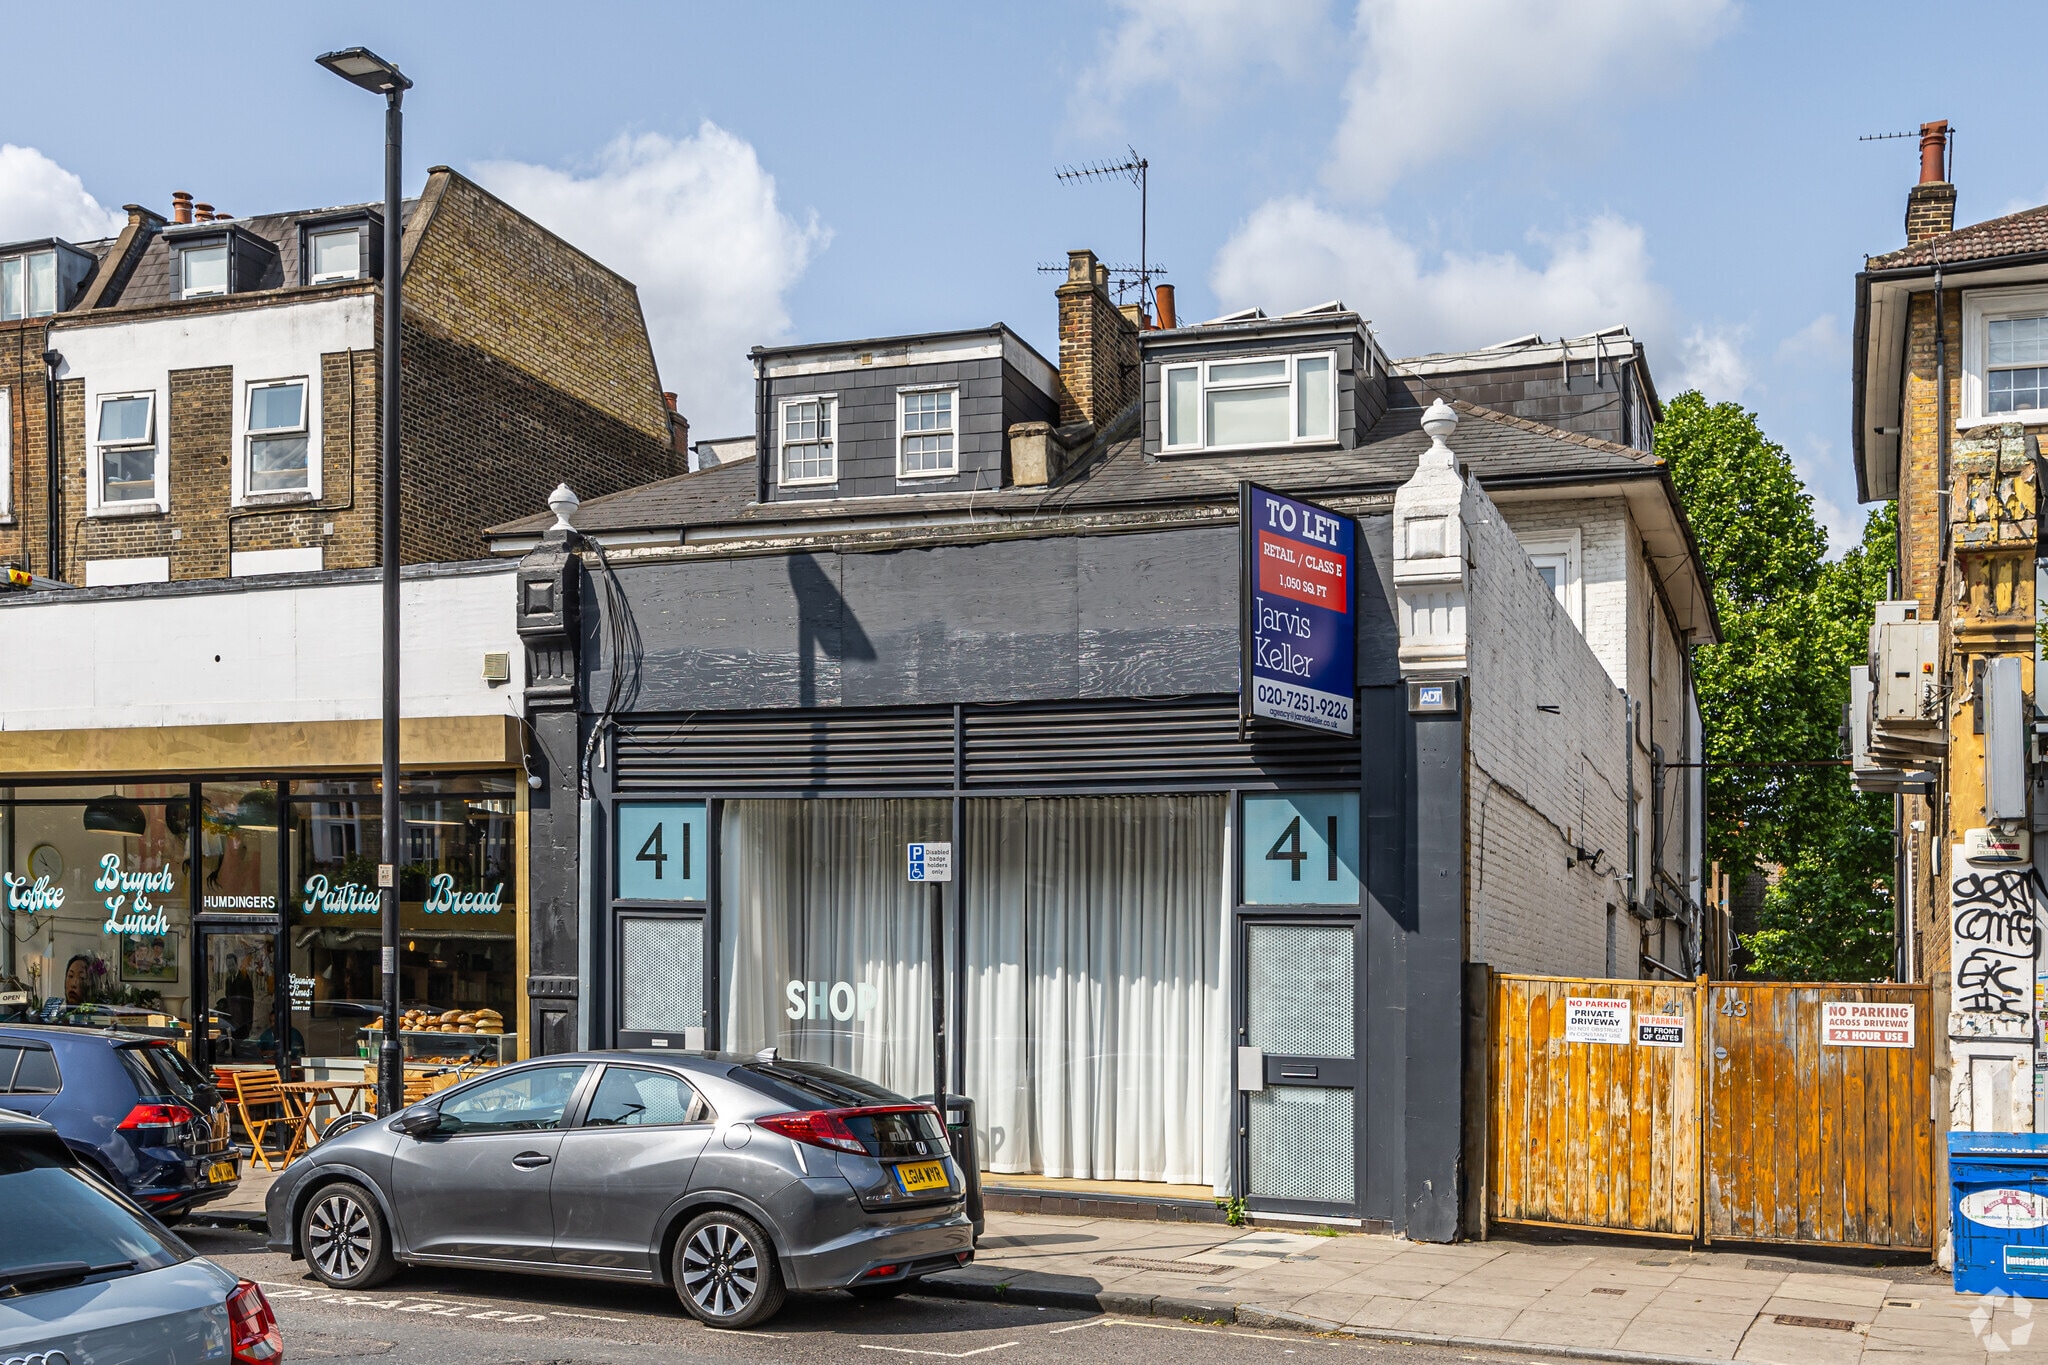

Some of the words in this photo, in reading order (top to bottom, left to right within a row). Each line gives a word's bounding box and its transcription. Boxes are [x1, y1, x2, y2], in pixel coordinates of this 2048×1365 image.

[1266, 498, 1297, 532] TO
[1302, 510, 1340, 546] LET
[1263, 542, 1296, 563] RETAIL
[1305, 555, 1334, 575] CLASS
[1336, 564, 1342, 577] E
[1279, 574, 1301, 590] 1,050
[1316, 584, 1327, 597] FT
[1254, 596, 1311, 639] Jarvis
[1255, 636, 1313, 678] Keller
[1258, 684, 1348, 720] 020-7251-9226
[1421, 690, 1442, 702] ADT
[1269, 707, 1338, 729] agency@jarviskeller.co.uk
[635, 822, 691, 880] 41
[913, 846, 922, 860] P
[1265, 815, 1338, 882] 41
[94, 853, 175, 893] Brunch
[3, 871, 66, 913] Coffee
[132, 890, 153, 913] &
[203, 895, 276, 909] HUMDINGERS
[302, 873, 383, 915] Pastries
[423, 873, 504, 915] Bread
[103, 894, 171, 936] Lunch
[288, 973, 316, 988] Opening
[785, 979, 879, 1022] SHOP
[1585, 1000, 1627, 1008] PARKING
[1662, 1000, 1684, 1017] 41
[1721, 1000, 1747, 1017] 43
[1571, 1018, 1620, 1026] DRIVEWAY
[1574, 1009, 1614, 1018] PRIVATE
[1640, 1016, 1650, 1024] NO
[1651, 1016, 1684, 1026] PARKING
[1829, 1006, 1847, 1017] NO
[1852, 1007, 1909, 1018] PARKING
[1829, 1018, 1860, 1026] ACROSS
[1864, 1019, 1909, 1028] DRIVEWAY
[1653, 1027, 1679, 1035] FRONT
[1655, 1034, 1679, 1042] GATES
[1834, 1030, 1848, 1040] 24
[1852, 1031, 1881, 1041] HOUR
[1884, 1032, 1903, 1041] USE
[2006, 1255, 2048, 1267] Internati
[265, 1289, 547, 1323] DISABLED
